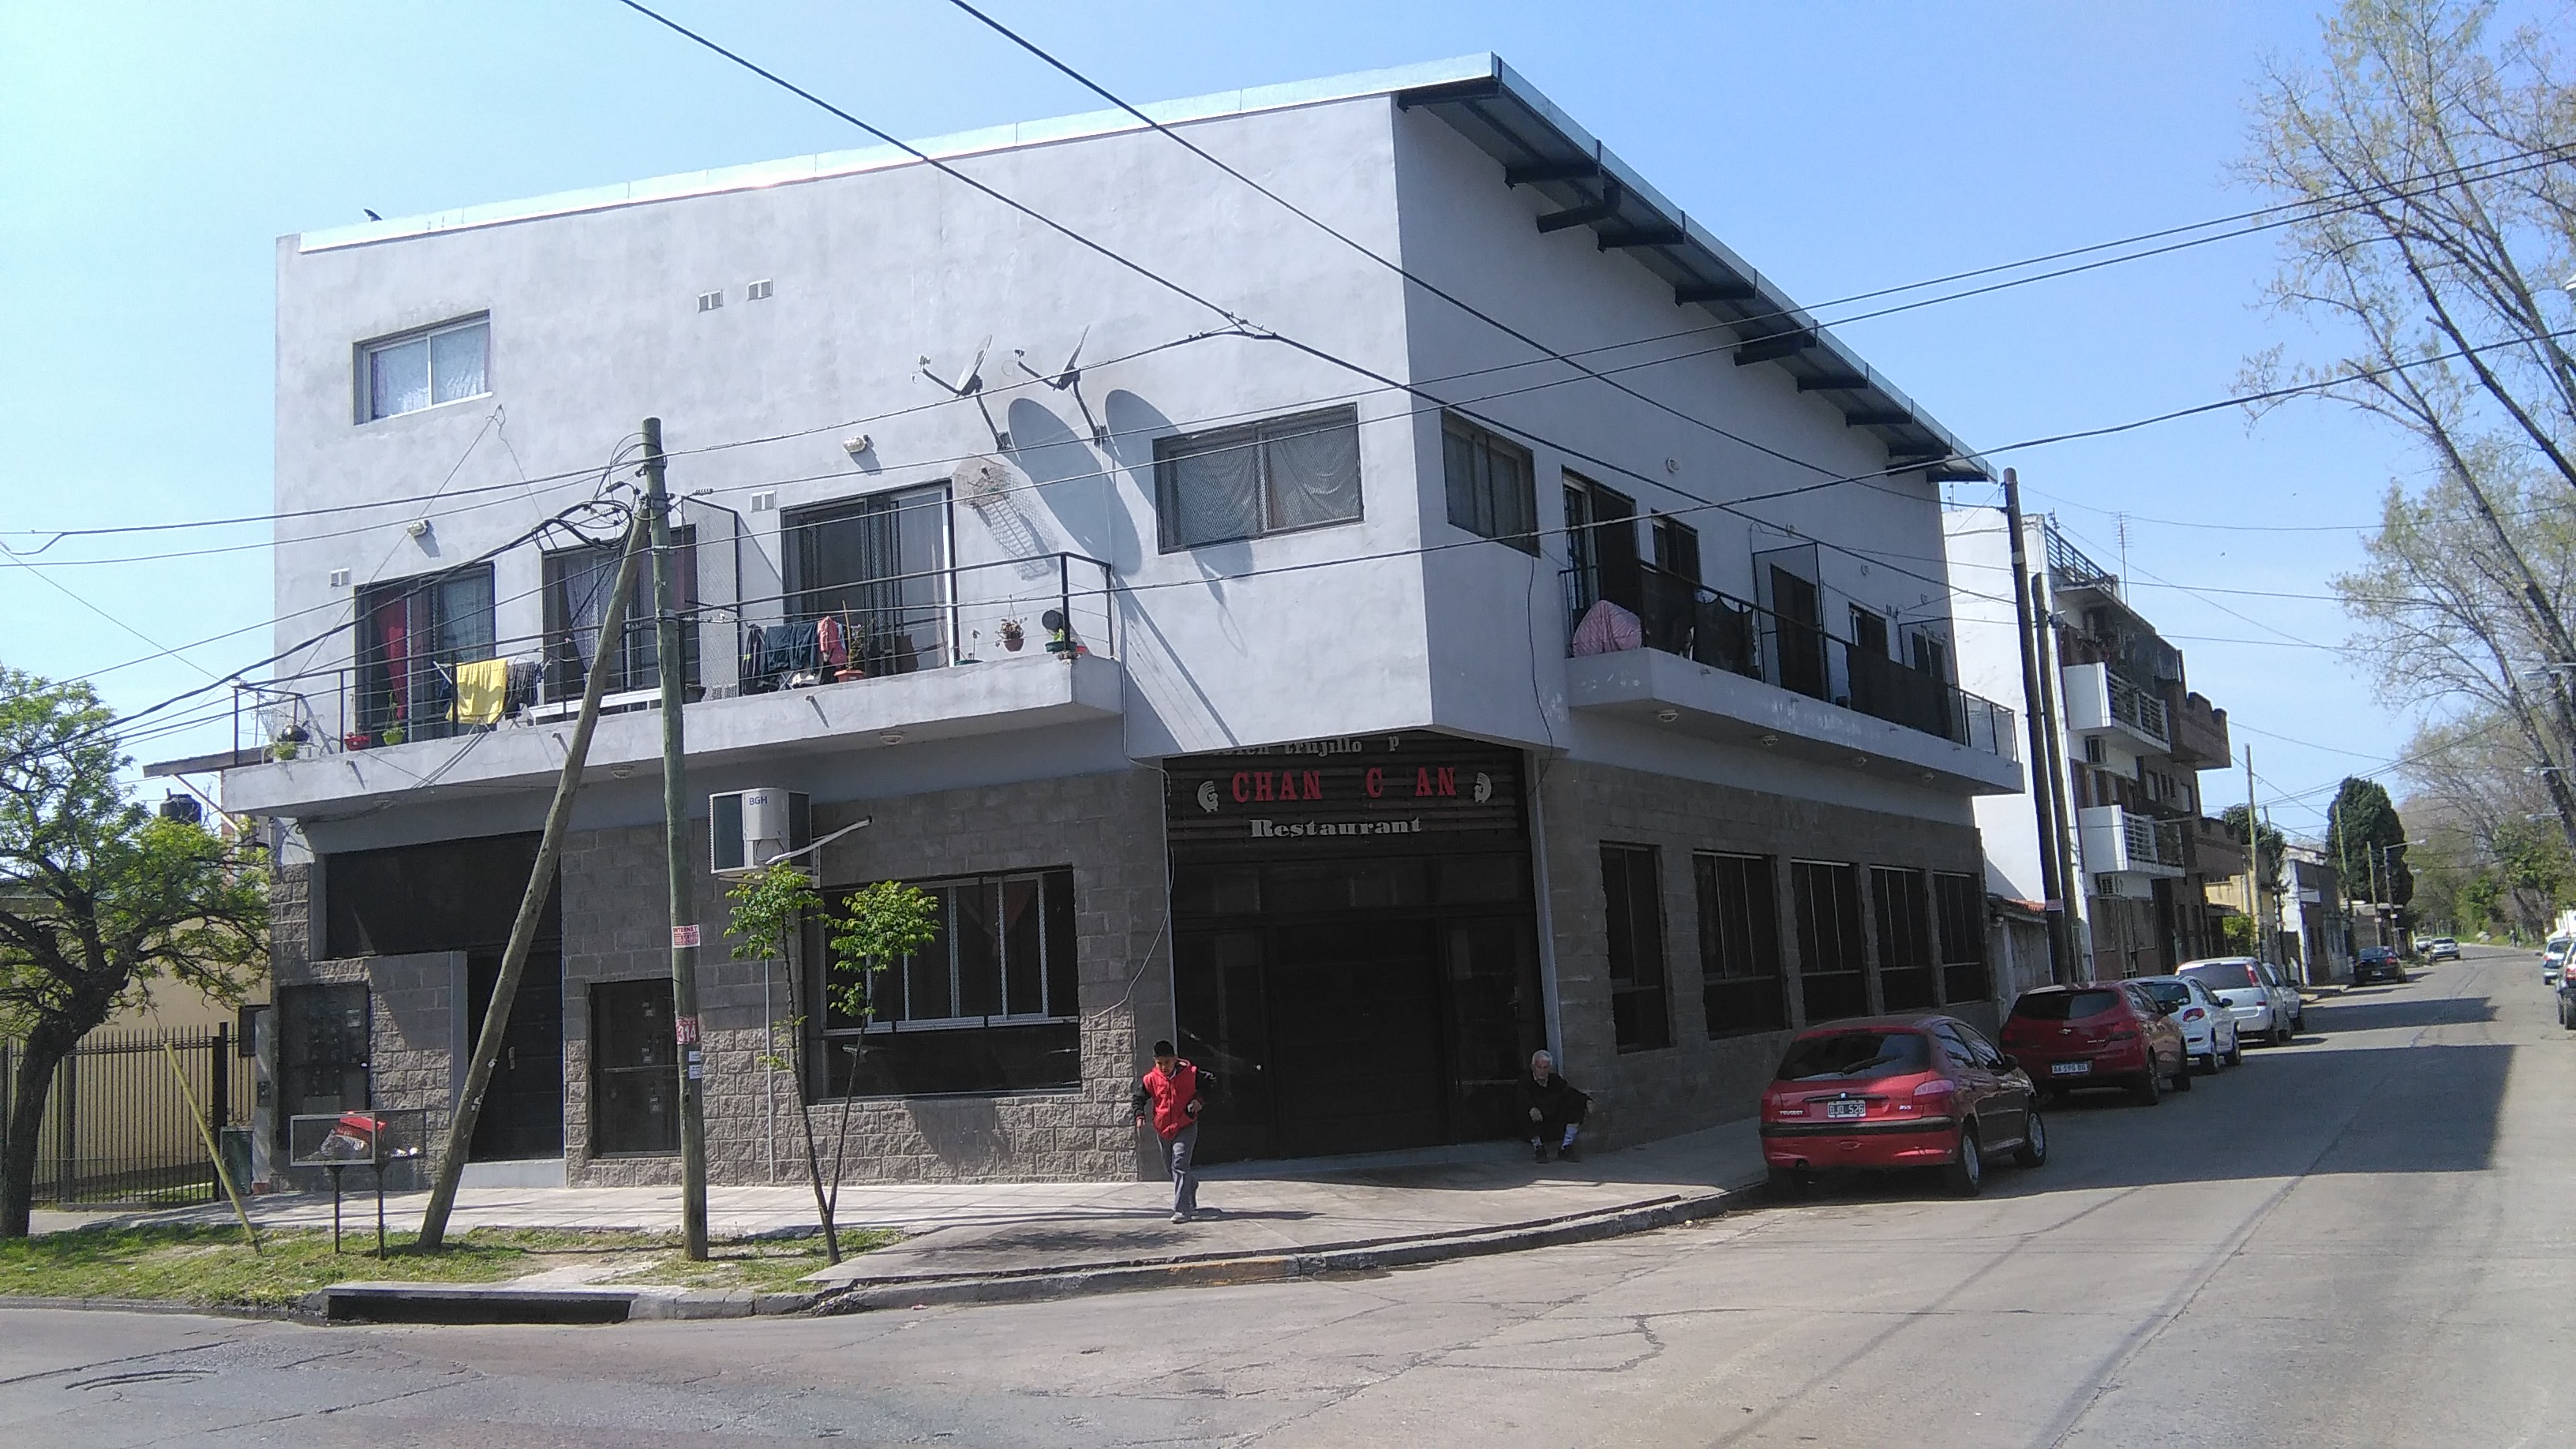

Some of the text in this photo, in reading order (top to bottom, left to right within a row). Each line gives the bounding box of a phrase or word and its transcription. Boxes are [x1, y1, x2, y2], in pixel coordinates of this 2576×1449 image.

[1284, 737, 1362, 757] trujillo
[1387, 736, 1399, 752] p
[1232, 770, 1323, 803] CHAN
[749, 796, 768, 806] BGH
[1249, 817, 1422, 838] Restaurant
[676, 1025, 696, 1043] 314
[1848, 1104, 1863, 1114] 526
